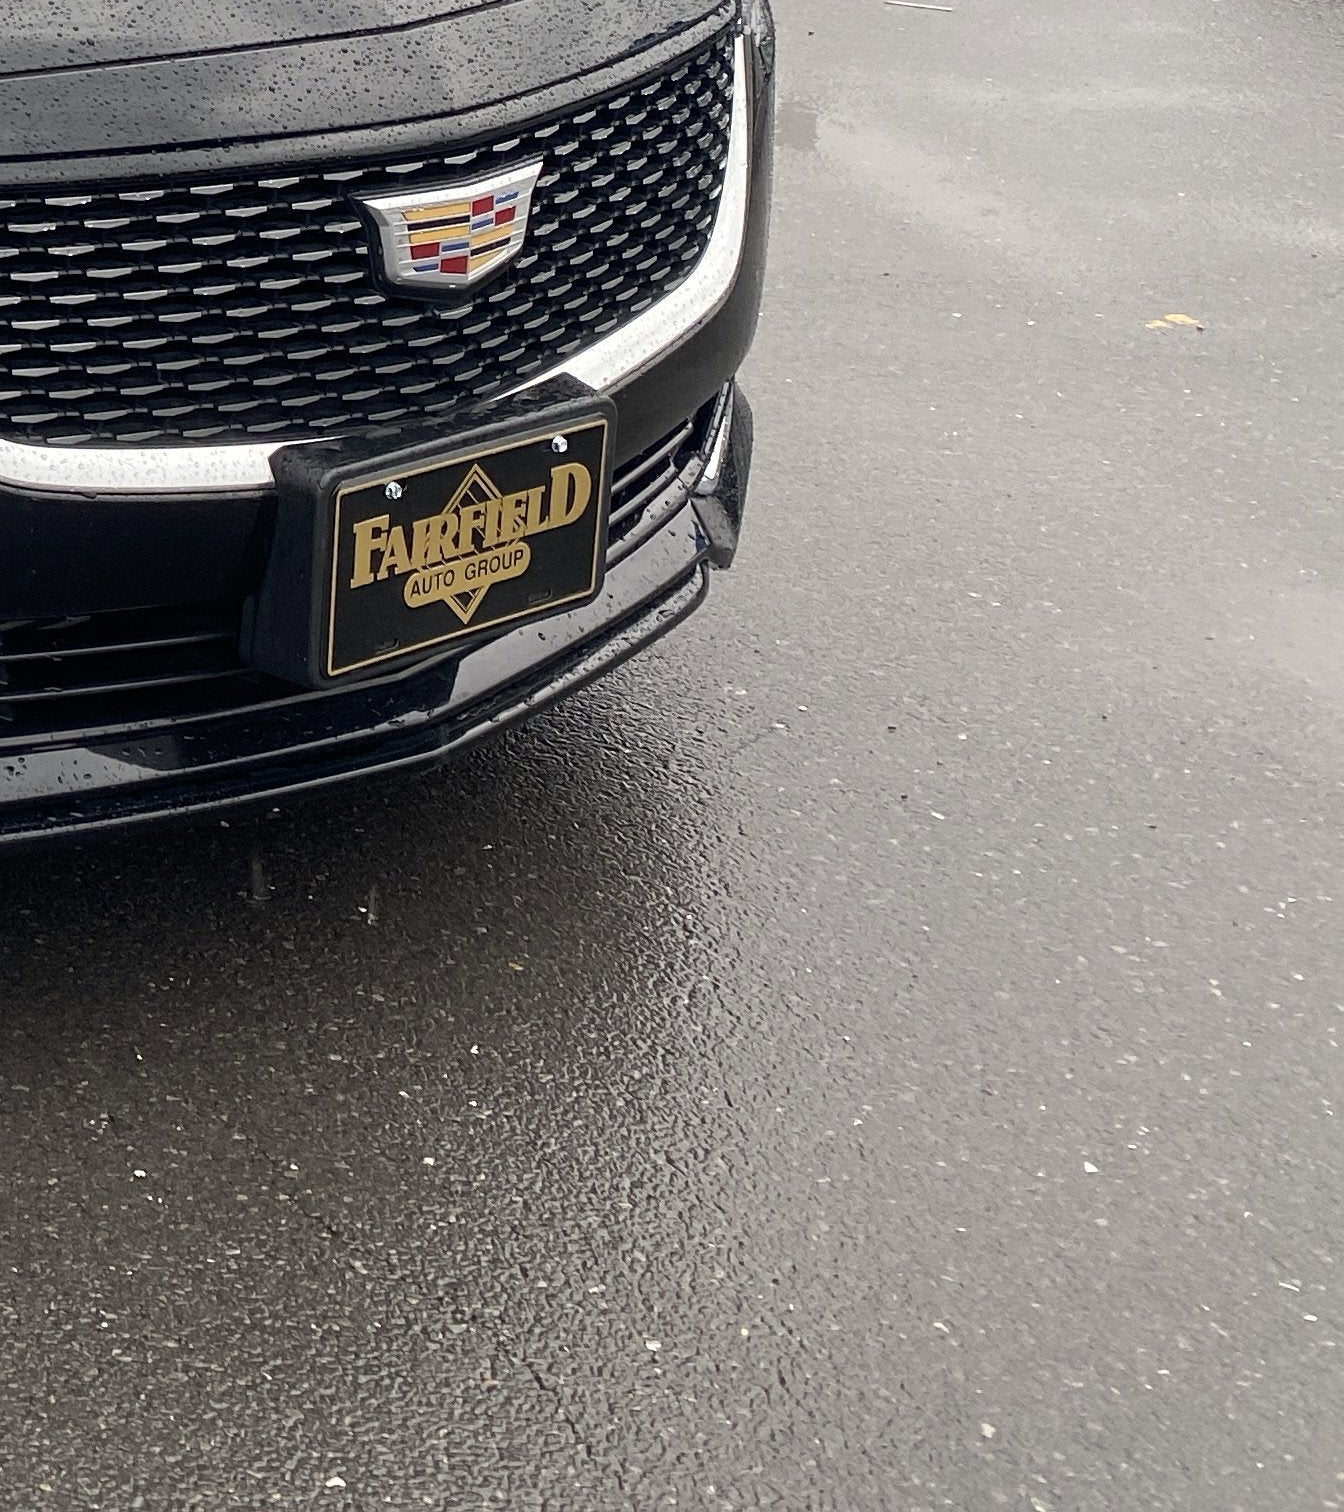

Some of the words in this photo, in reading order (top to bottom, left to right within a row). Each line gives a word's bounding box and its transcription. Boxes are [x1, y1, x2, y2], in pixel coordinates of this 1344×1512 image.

[350, 461, 593, 590] FAIRFIELD
[410, 569, 455, 598] AUTO
[464, 548, 524, 582] GROUP
